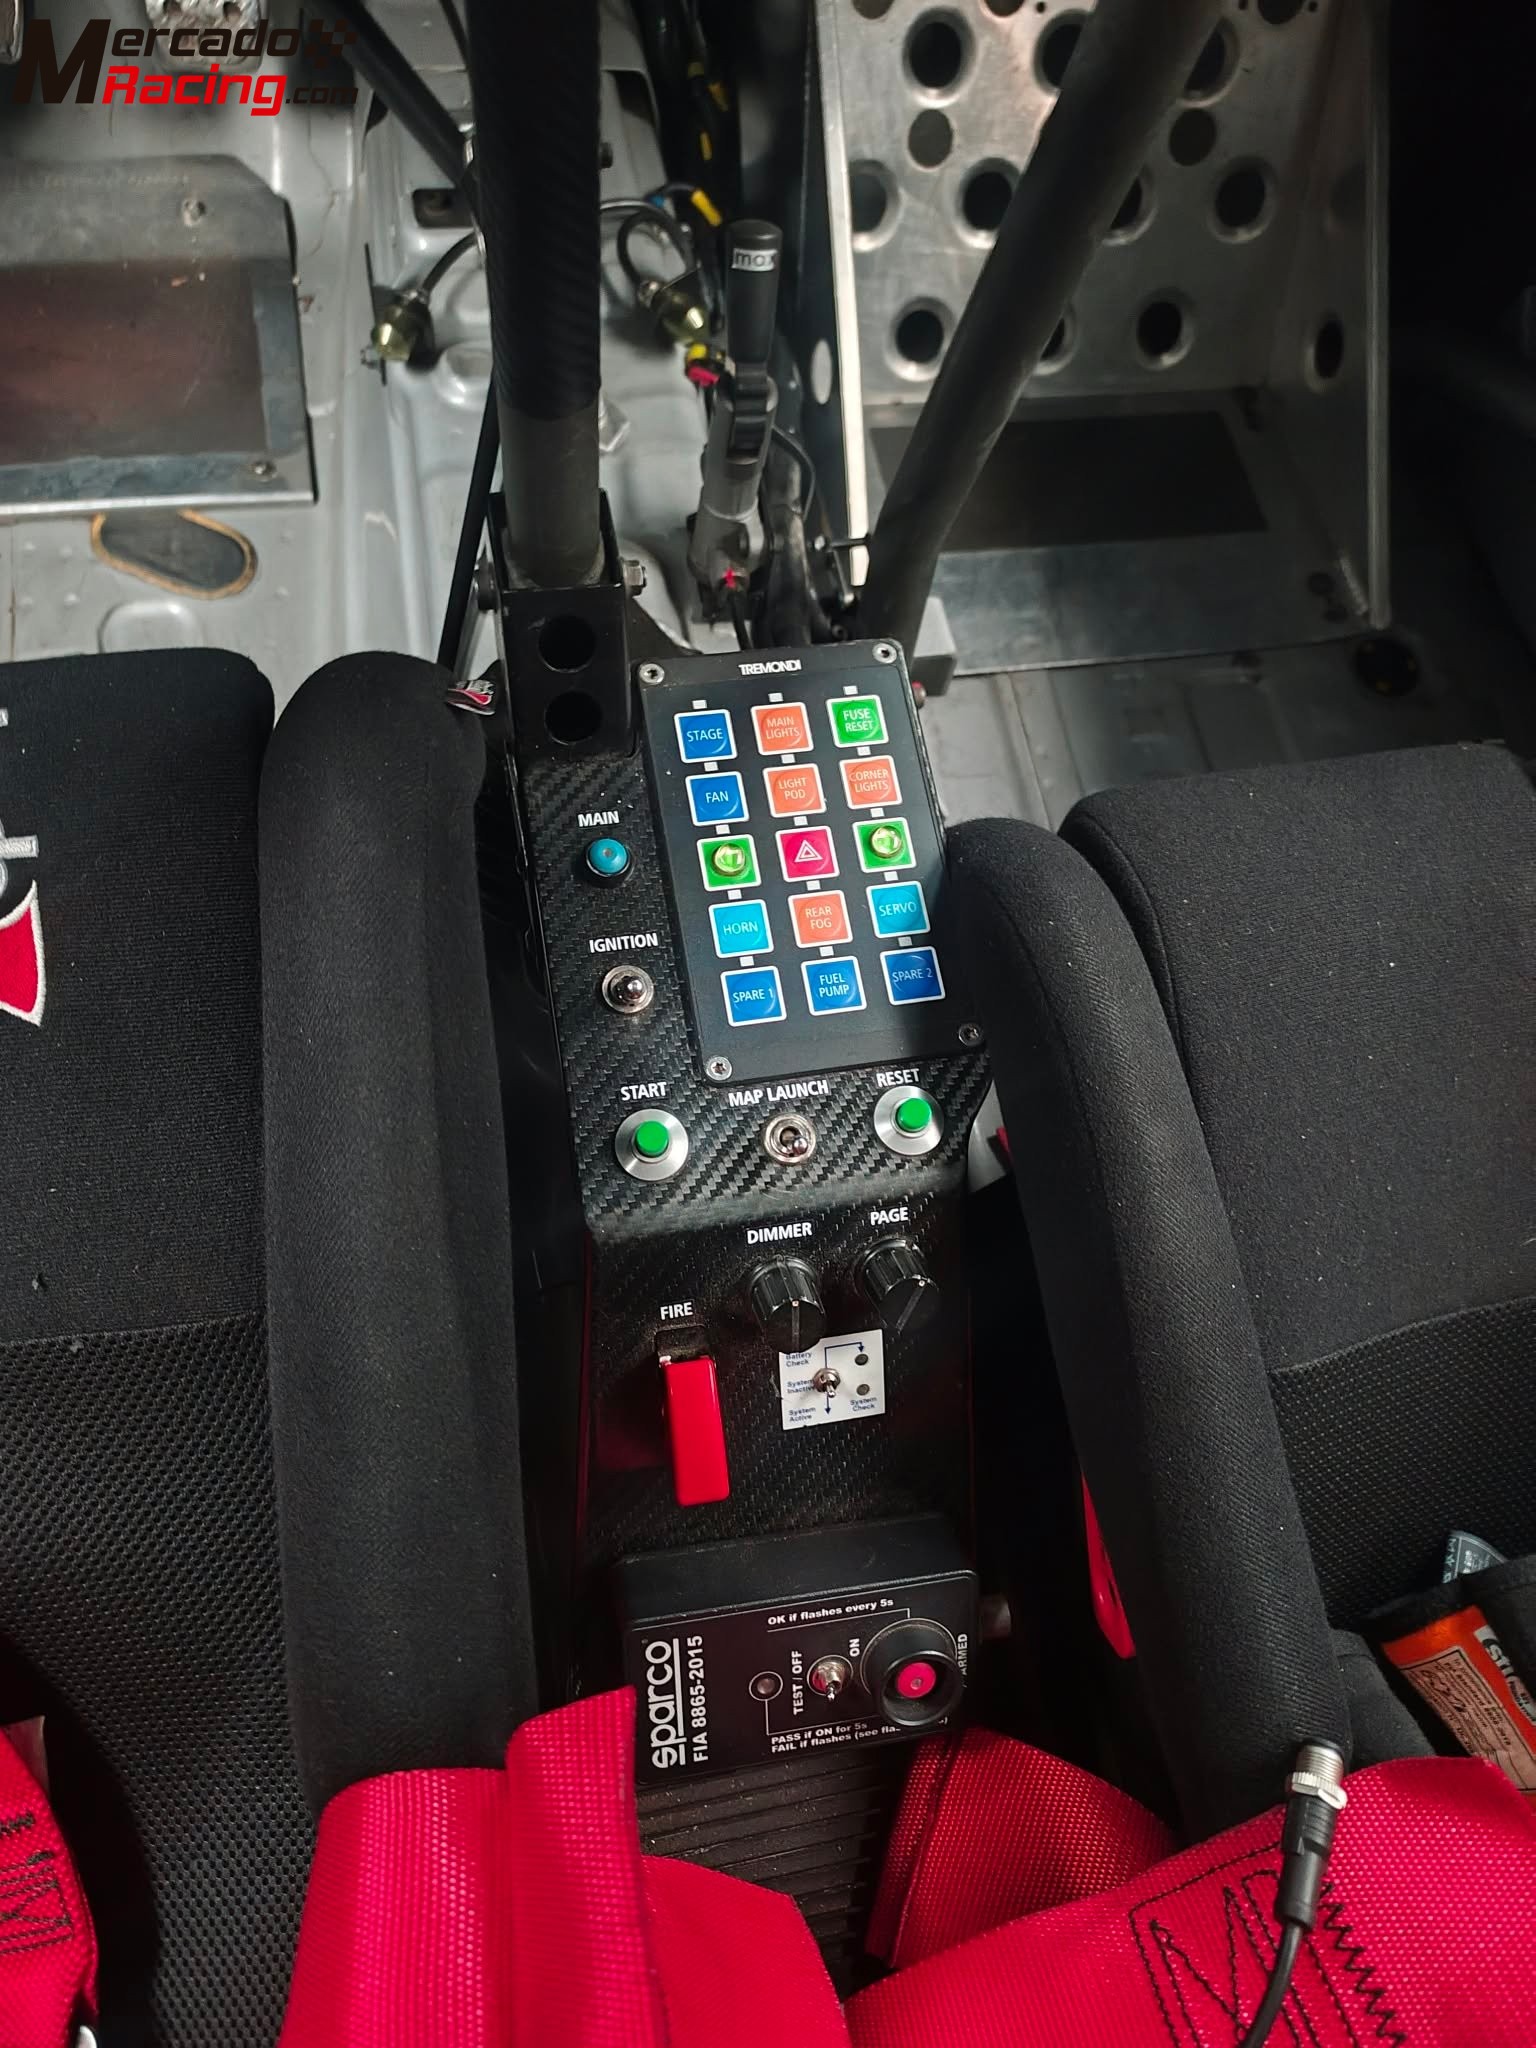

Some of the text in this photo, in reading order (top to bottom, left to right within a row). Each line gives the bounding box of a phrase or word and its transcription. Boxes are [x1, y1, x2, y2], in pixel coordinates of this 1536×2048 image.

[739, 660, 802, 676] TREMONDI
[767, 716, 795, 728] MAIN
[843, 708, 870, 721] FUSE
[766, 726, 800, 740] LIGHTS
[846, 719, 873, 732] RESET
[686, 728, 723, 743] STAGE
[849, 768, 889, 782] CORNER
[779, 777, 806, 790] LIGHT
[855, 779, 889, 793] LIGHTS
[706, 790, 729, 803] FAN
[784, 788, 806, 801] POD
[577, 810, 620, 828] MAIN
[805, 906, 832, 918] REAR
[879, 902, 917, 917] SERVO
[723, 921, 758, 936] HORN
[810, 917, 832, 930] FOG
[589, 932, 659, 953] IGNITION
[819, 973, 845, 985] FUEL
[892, 967, 933, 984] SPARE 2
[732, 988, 773, 1003] SPARE 1
[819, 984, 850, 998] PUMP
[876, 1068, 920, 1087] RESET
[620, 1082, 667, 1101] START
[728, 1080, 829, 1107] MAP LAUNCH
[870, 1207, 909, 1225] PAGE
[747, 1222, 812, 1245] DIMMER
[660, 1302, 693, 1320] FIRE
[786, 1359, 809, 1368] Check
[850, 1397, 877, 1406] System
[852, 1404, 875, 1412] Check
[789, 1407, 816, 1416] System
[789, 1414, 812, 1423] Active
[767, 1598, 894, 1626] OK if flashes every 5s
[850, 1638, 861, 1657] ON
[791, 1651, 802, 1674] OFF
[645, 1640, 688, 1769] sparco
[687, 1635, 709, 1763] FIA 8865-2015
[793, 1682, 804, 1715] TEST
[771, 1733, 801, 1745] PASS
[804, 1730, 813, 1740] if
[816, 1727, 833, 1738] ON
[835, 1724, 851, 1735] for
[771, 1744, 797, 1754] FAIL
[800, 1740, 808, 1749] if
[811, 1733, 852, 1747] flashes
